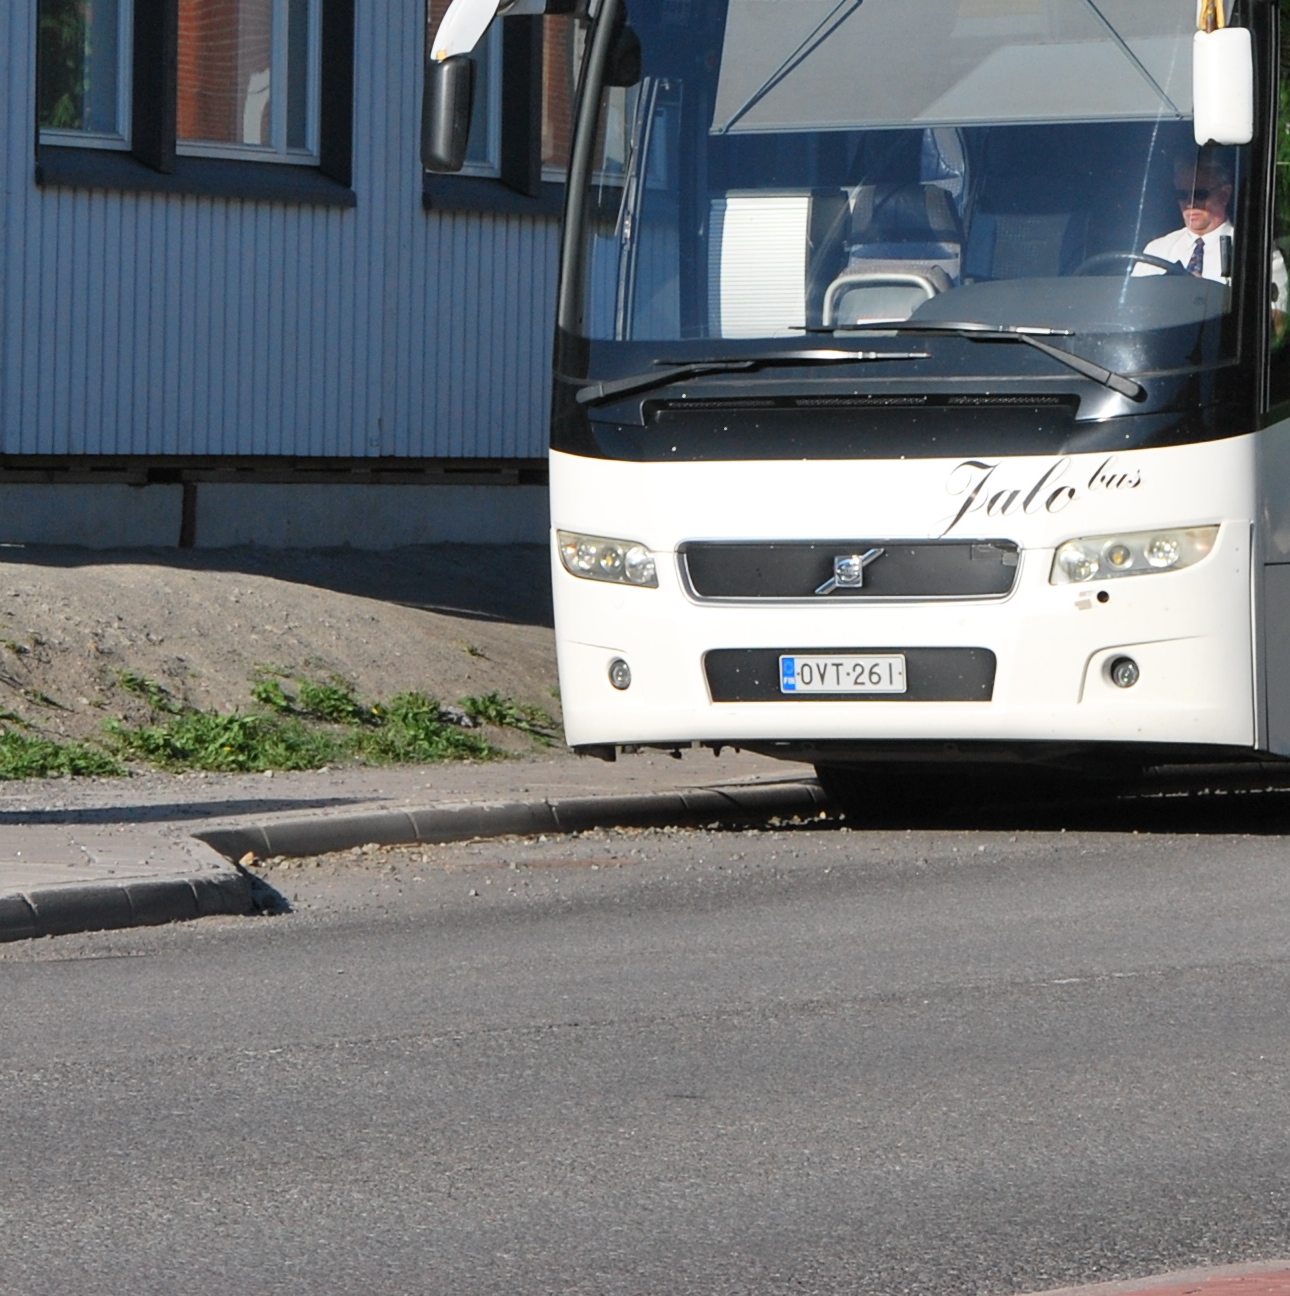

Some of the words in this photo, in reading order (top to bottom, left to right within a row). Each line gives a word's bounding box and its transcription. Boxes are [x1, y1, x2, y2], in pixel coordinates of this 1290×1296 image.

[929, 456, 1080, 539] Jalo
[1088, 456, 1143, 490] bus
[800, 662, 893, 686] OVT-261
